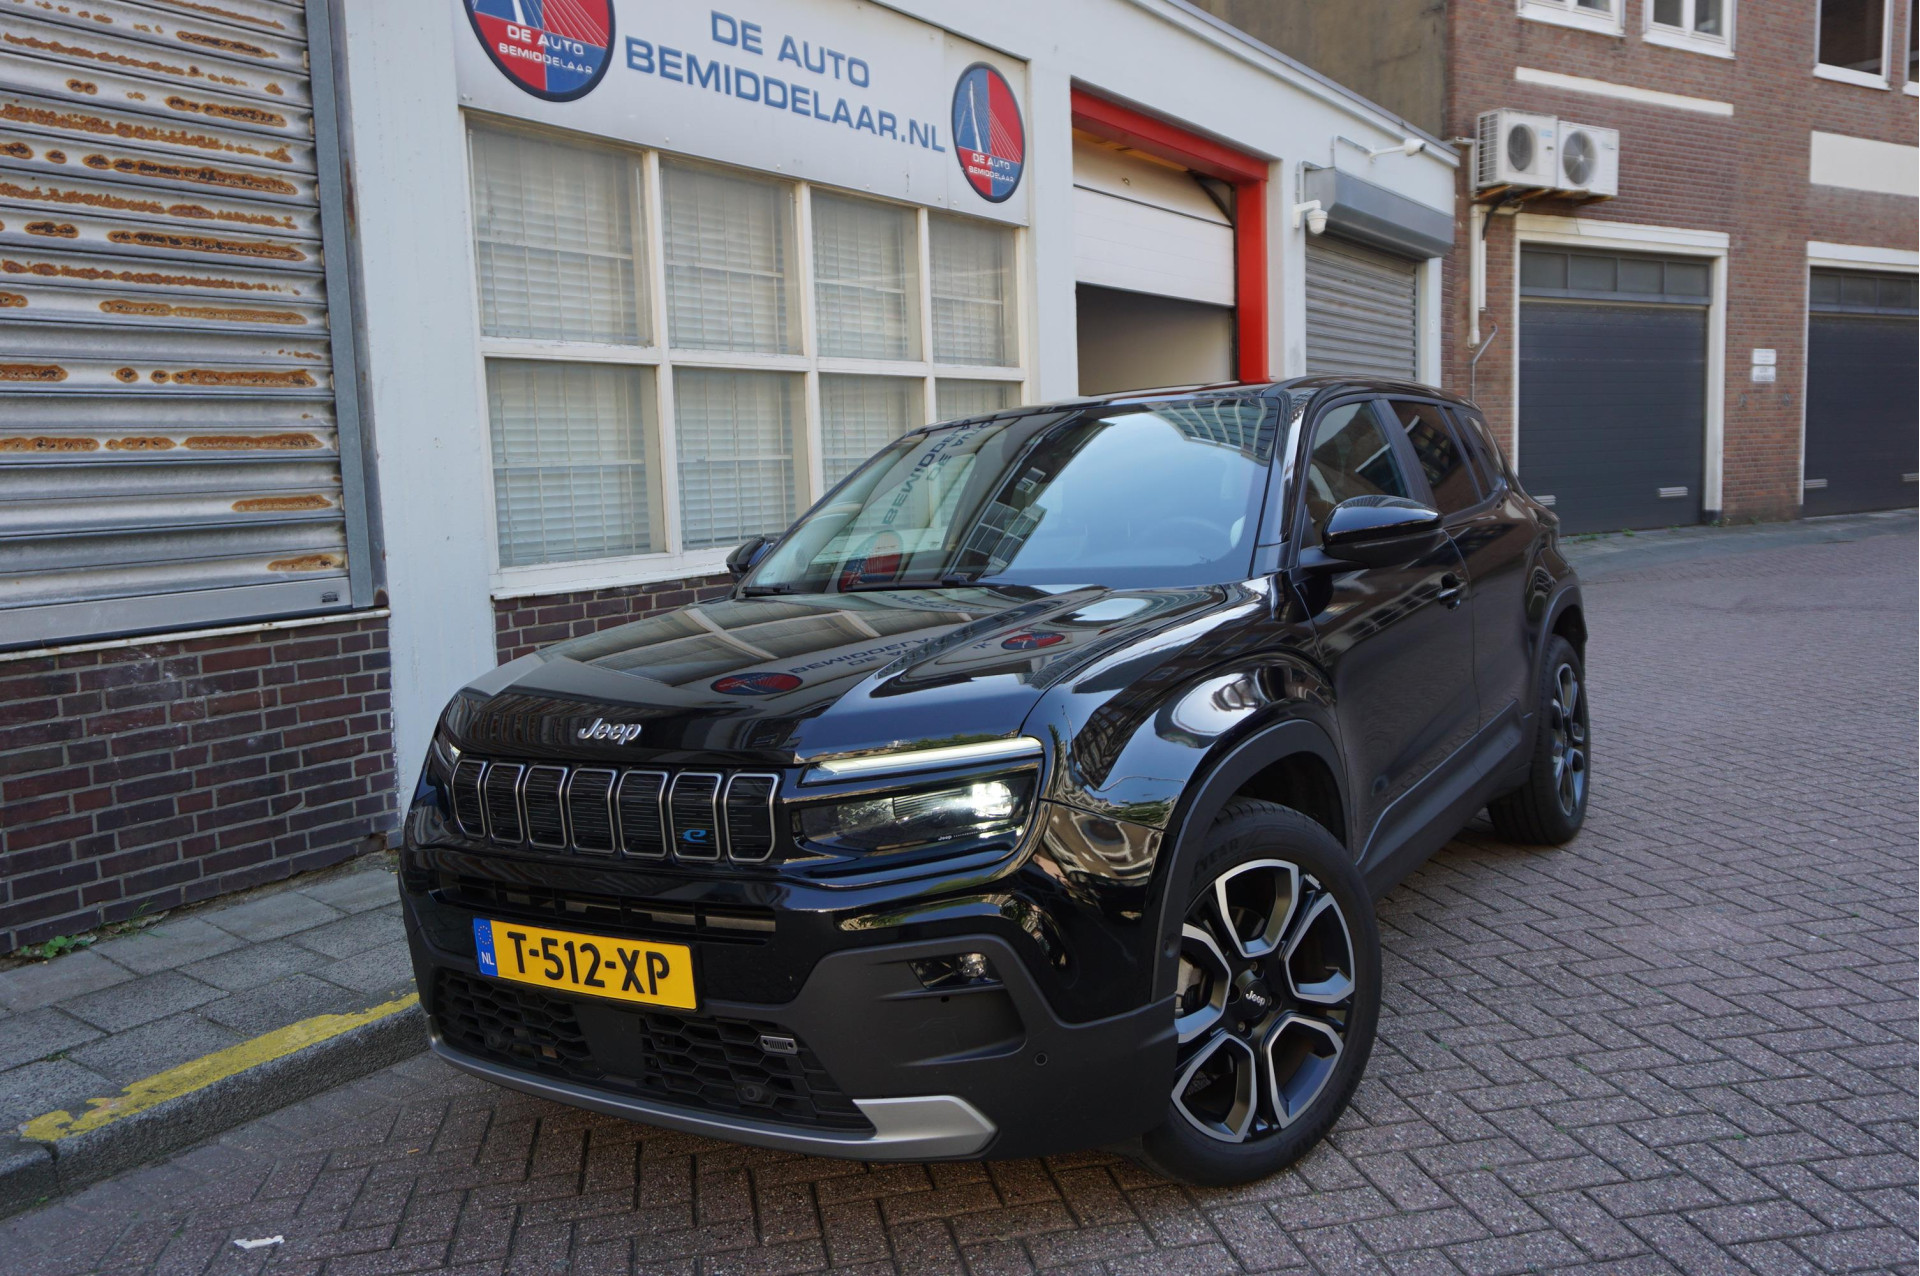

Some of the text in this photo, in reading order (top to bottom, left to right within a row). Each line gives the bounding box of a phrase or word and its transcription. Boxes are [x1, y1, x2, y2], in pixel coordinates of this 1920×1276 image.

[506, 24, 584, 56] DE AUTO
[711, 9, 870, 88] DE AUTO
[498, 43, 592, 74] BEMIDDELAAR
[625, 35, 946, 153] BEMIDDELAAR.NL
[968, 166, 1014, 182] BEMIDDELAAR
[972, 153, 1010, 170] DE AUTO
[577, 717, 642, 745] Jeep
[481, 951, 495, 966] NL
[507, 931, 670, 995] T-512-XP
[1245, 990, 1266, 1007] Jeep
